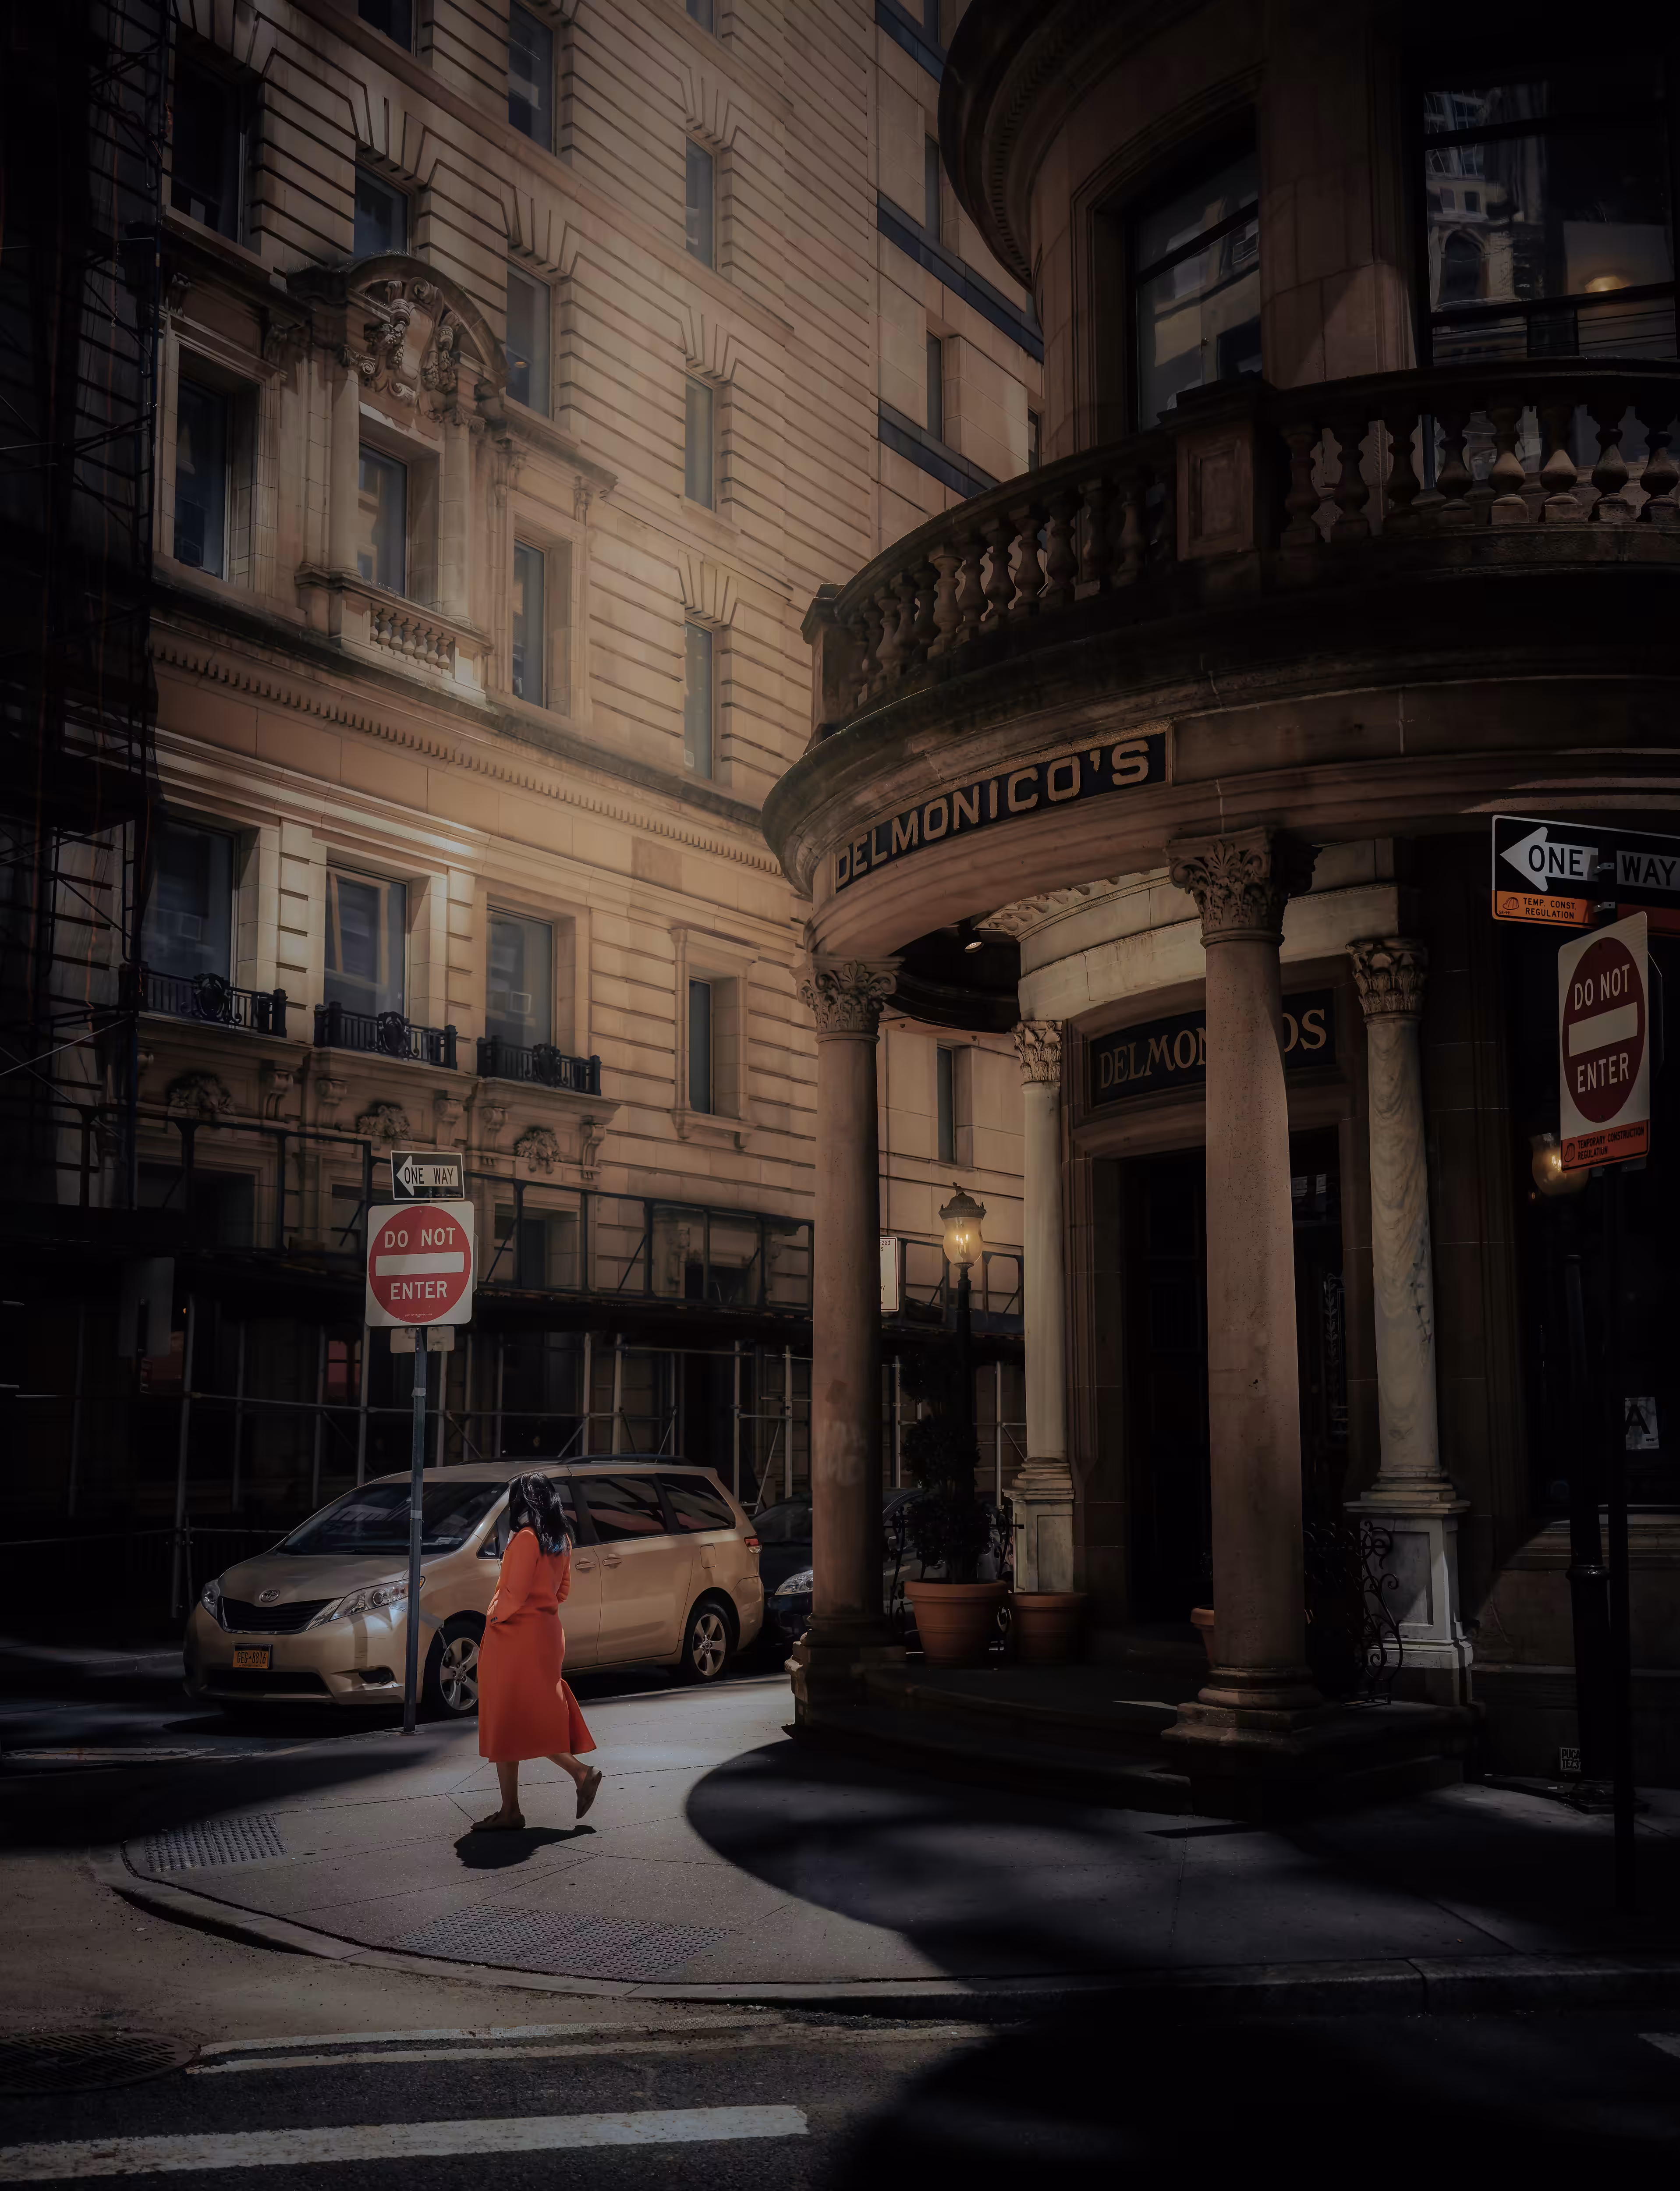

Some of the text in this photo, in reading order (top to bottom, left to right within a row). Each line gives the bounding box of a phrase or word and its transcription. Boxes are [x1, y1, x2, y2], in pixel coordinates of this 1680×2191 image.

[836, 739, 1149, 889] DELMONICO'S
[1528, 845, 1677, 886] ONE WAY
[1523, 897, 1576, 910] TEMP. CONST.
[1525, 908, 1574, 919] REGULATION
[1574, 964, 1630, 1010] DO NOT
[1098, 1008, 1327, 1090] DELMOOS
[1577, 1052, 1629, 1093] ENTER
[1578, 1125, 1645, 1149] TEMPORARY CONSTRUCTION
[1577, 1145, 1608, 1160] REGULATION
[404, 1167, 453, 1184] ONE WAY
[385, 1227, 456, 1248] DO NOT
[390, 1281, 447, 1300] ENTER
